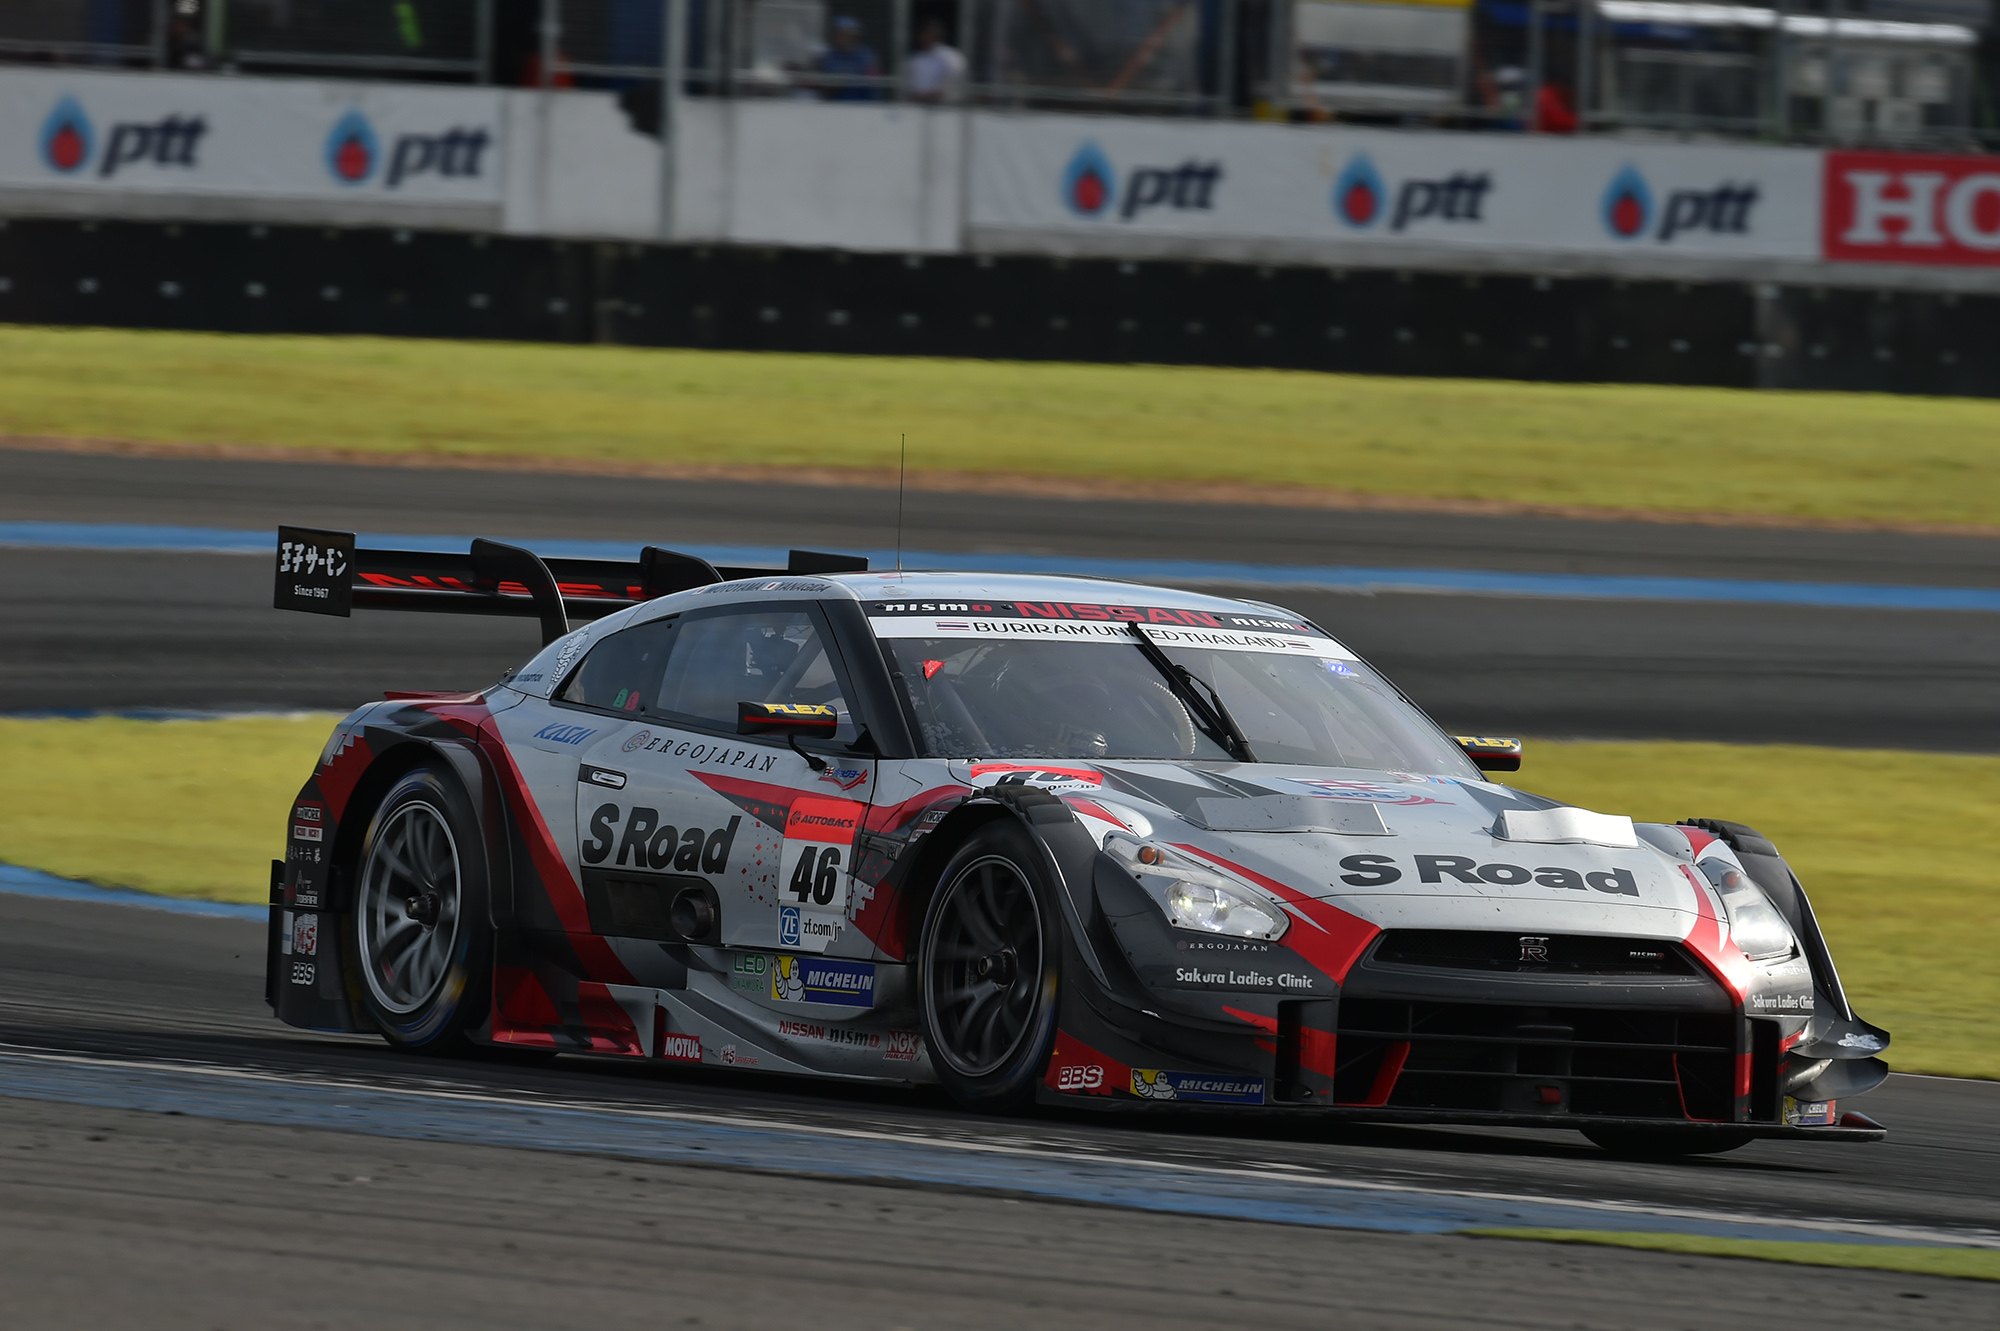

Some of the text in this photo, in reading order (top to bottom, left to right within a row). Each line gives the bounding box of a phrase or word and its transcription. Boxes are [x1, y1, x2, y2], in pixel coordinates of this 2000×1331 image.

[99, 112, 208, 178] ptt
[387, 122, 492, 188] ptt
[1122, 160, 1223, 220] ptt
[1392, 170, 1494, 232] ptt
[1658, 180, 1760, 242] ptt
[294, 584, 329, 599] Since 1967
[1014, 602, 1224, 627] NISSAN
[973, 622, 1286, 649] BURIRAM UNIED THAILAND
[765, 704, 834, 716] FLEX
[1456, 736, 1518, 748] FLEX
[644, 736, 778, 773] ERGOJAPAN
[800, 814, 855, 829] AUTOBACS
[582, 803, 742, 874] S Road
[789, 846, 841, 905] 46
[1339, 855, 1640, 897] S Road
[1188, 942, 1268, 952] ERGOJAPAN
[733, 954, 767, 974] LED
[806, 970, 874, 991] MICHELIN
[1176, 967, 1313, 989] Sakura Ladies Clinic
[778, 1020, 826, 1040] NISSAN
[665, 1036, 700, 1059] MOTUL
[887, 1031, 918, 1054] NGK
[1059, 1066, 1102, 1089] BBS
[1178, 1079, 1264, 1094] MICHELIN
